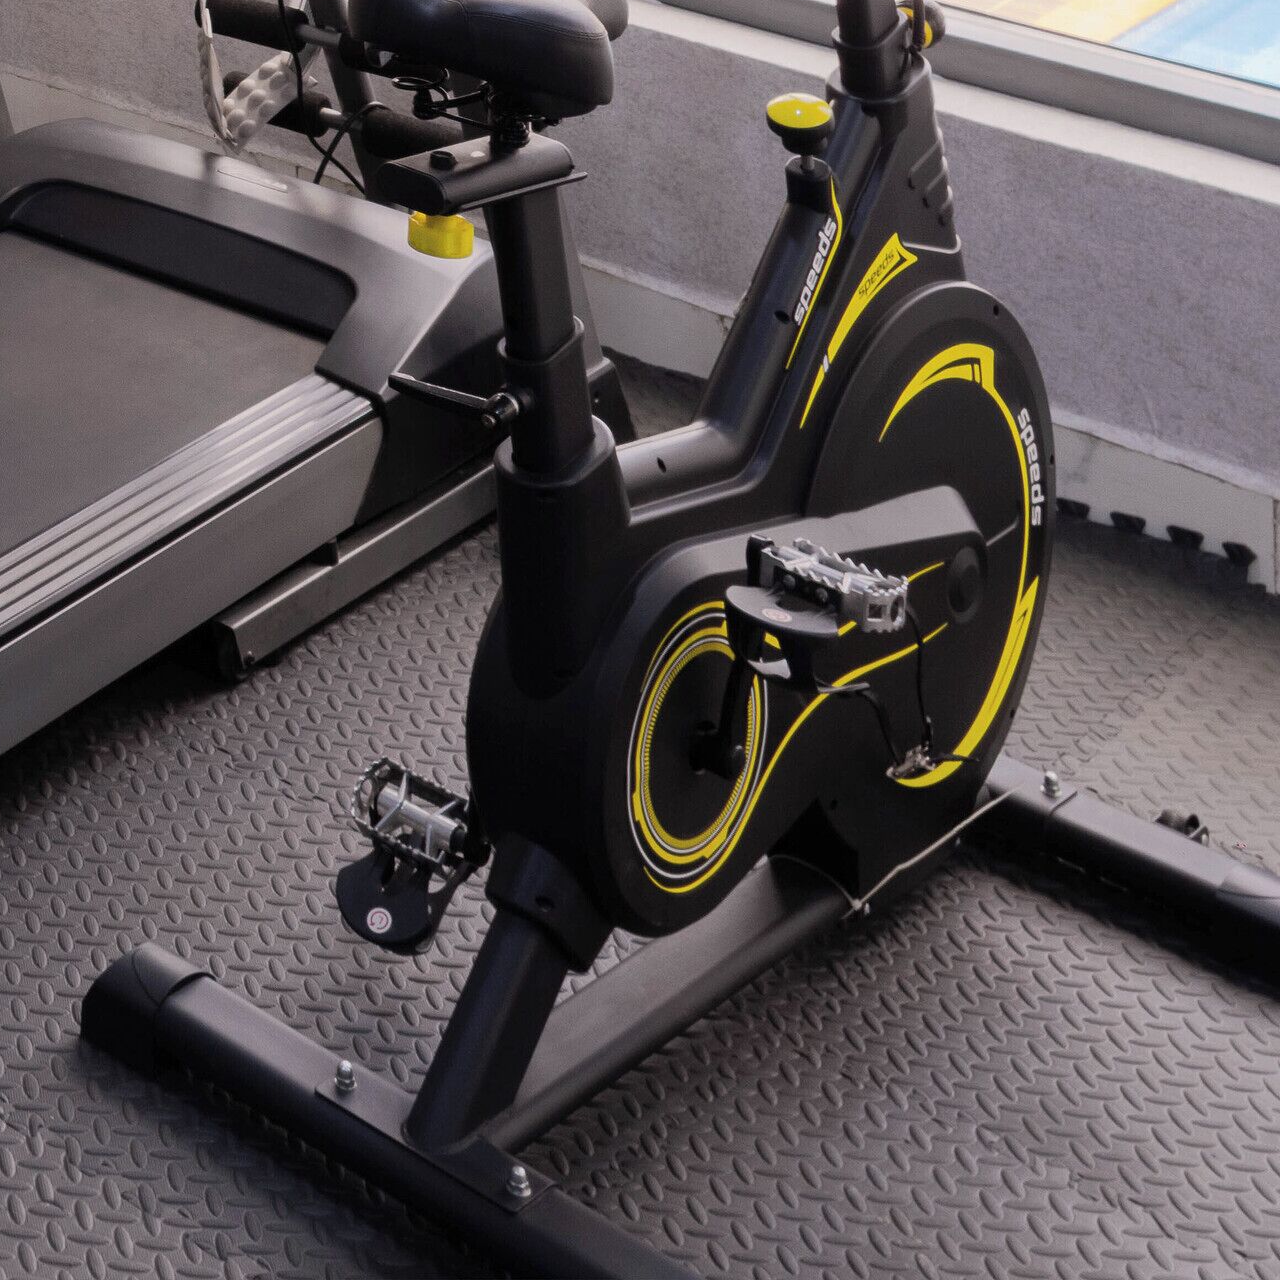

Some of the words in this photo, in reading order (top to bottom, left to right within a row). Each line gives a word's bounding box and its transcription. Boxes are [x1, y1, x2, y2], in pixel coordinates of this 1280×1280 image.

[794, 217, 837, 325] speeds
[858, 251, 895, 298] speeds
[1018, 408, 1043, 526] speeds
